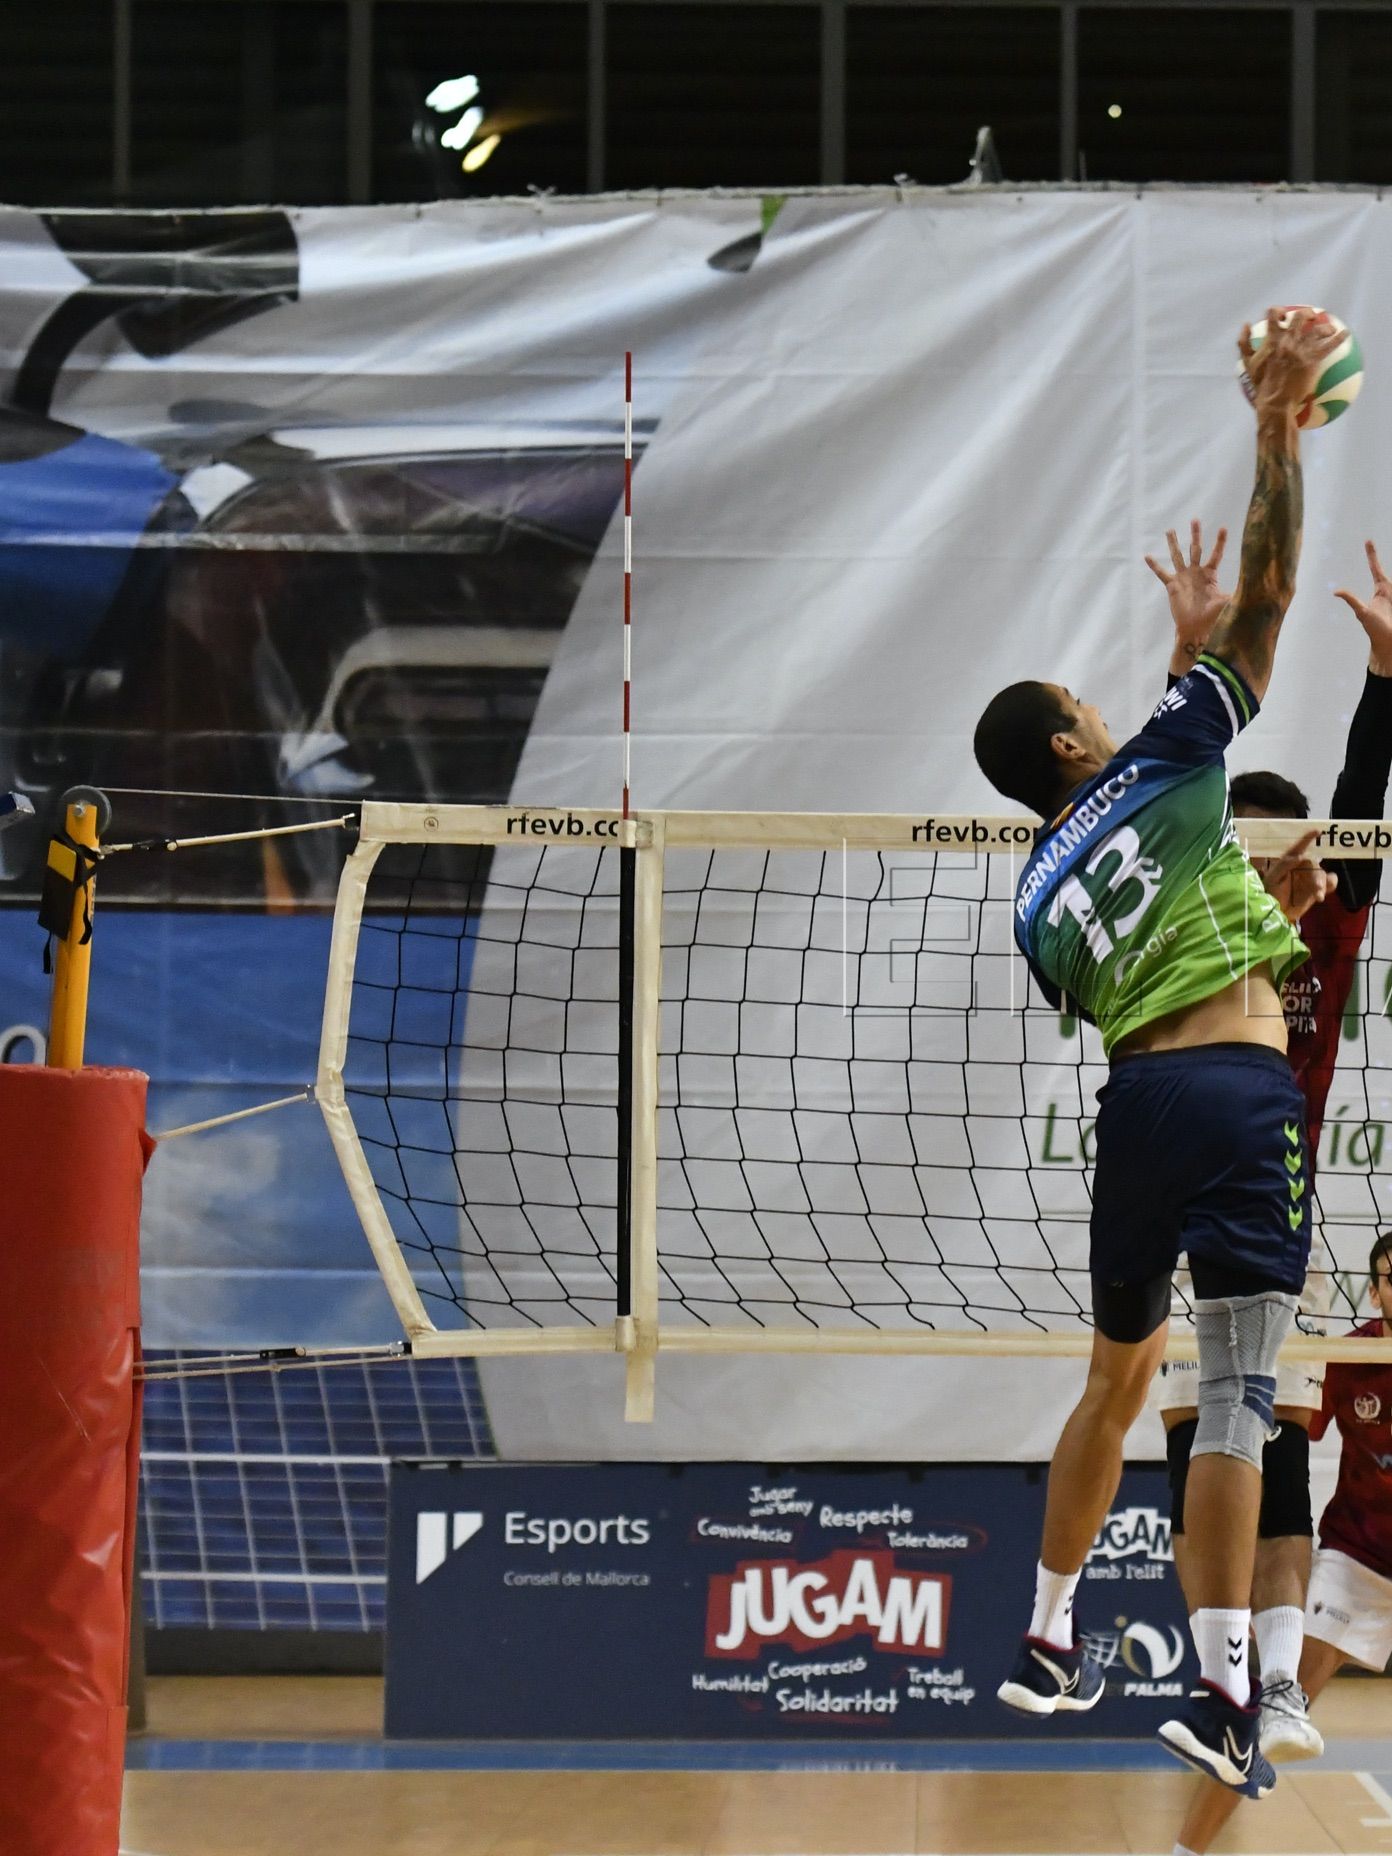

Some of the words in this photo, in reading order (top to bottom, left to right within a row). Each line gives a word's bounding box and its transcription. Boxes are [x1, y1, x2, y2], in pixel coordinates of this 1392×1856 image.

[507, 812, 619, 837] rfevb.c
[912, 818, 1041, 843] rfevb.co
[1016, 764, 1139, 922] PERNAMBUCO
[1047, 825, 1163, 964] 13
[748, 1485, 798, 1504] Jugar
[819, 1503, 914, 1533] Respecte
[504, 1511, 650, 1553] Esports
[503, 1570, 559, 1587] Consell
[562, 1570, 582, 1587] de
[585, 1570, 650, 1587] Mallorca
[1086, 1562, 1121, 1580] amb
[714, 1558, 943, 1650] JUGAM
[691, 1673, 770, 1694] Humilitat
[906, 1666, 965, 1687] Treball
[775, 1686, 901, 1714] Solidaritat
[907, 1685, 927, 1700] en
[929, 1686, 977, 1706] equip
[1123, 1682, 1184, 1698] PALMA
